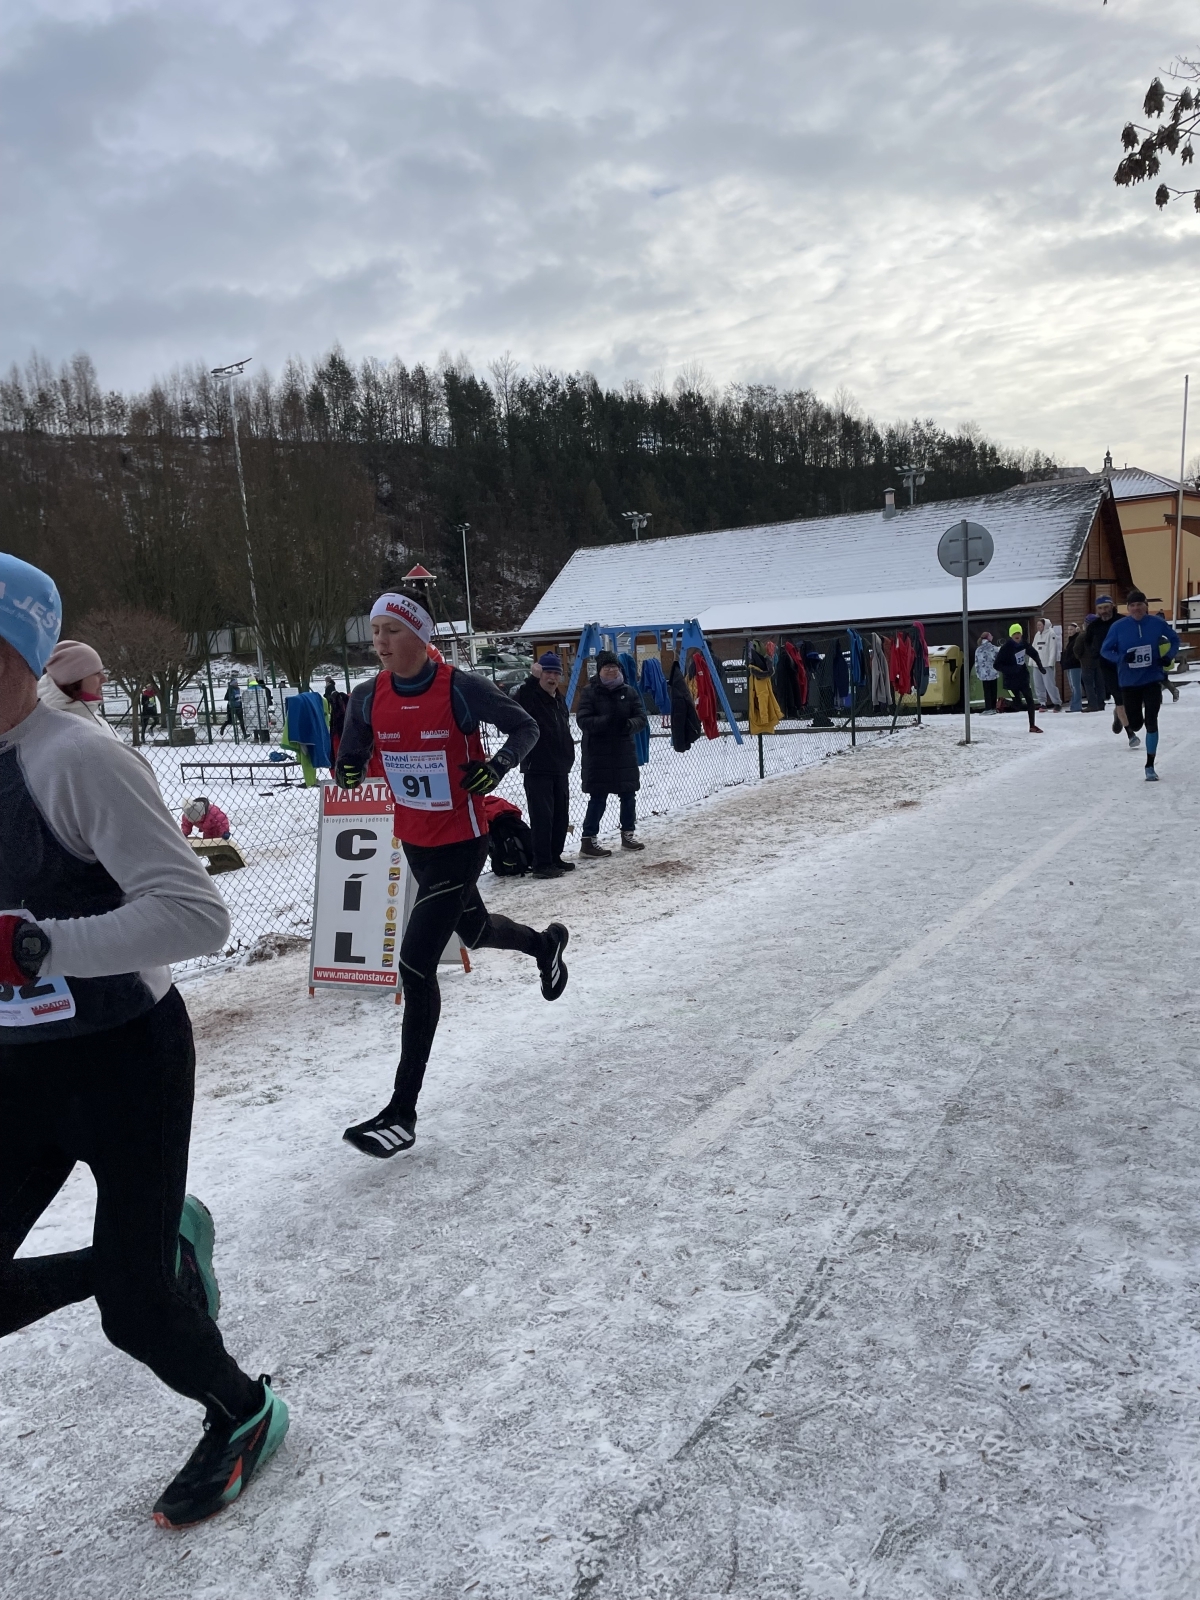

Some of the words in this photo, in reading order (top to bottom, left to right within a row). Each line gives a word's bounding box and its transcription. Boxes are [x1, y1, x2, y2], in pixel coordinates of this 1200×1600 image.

[384, 754, 409, 762] ZIMNÍ
[402, 775, 432, 798] 91
[334, 828, 378, 965] CÍL
[316, 970, 394, 983] www.maratonstav.cz
